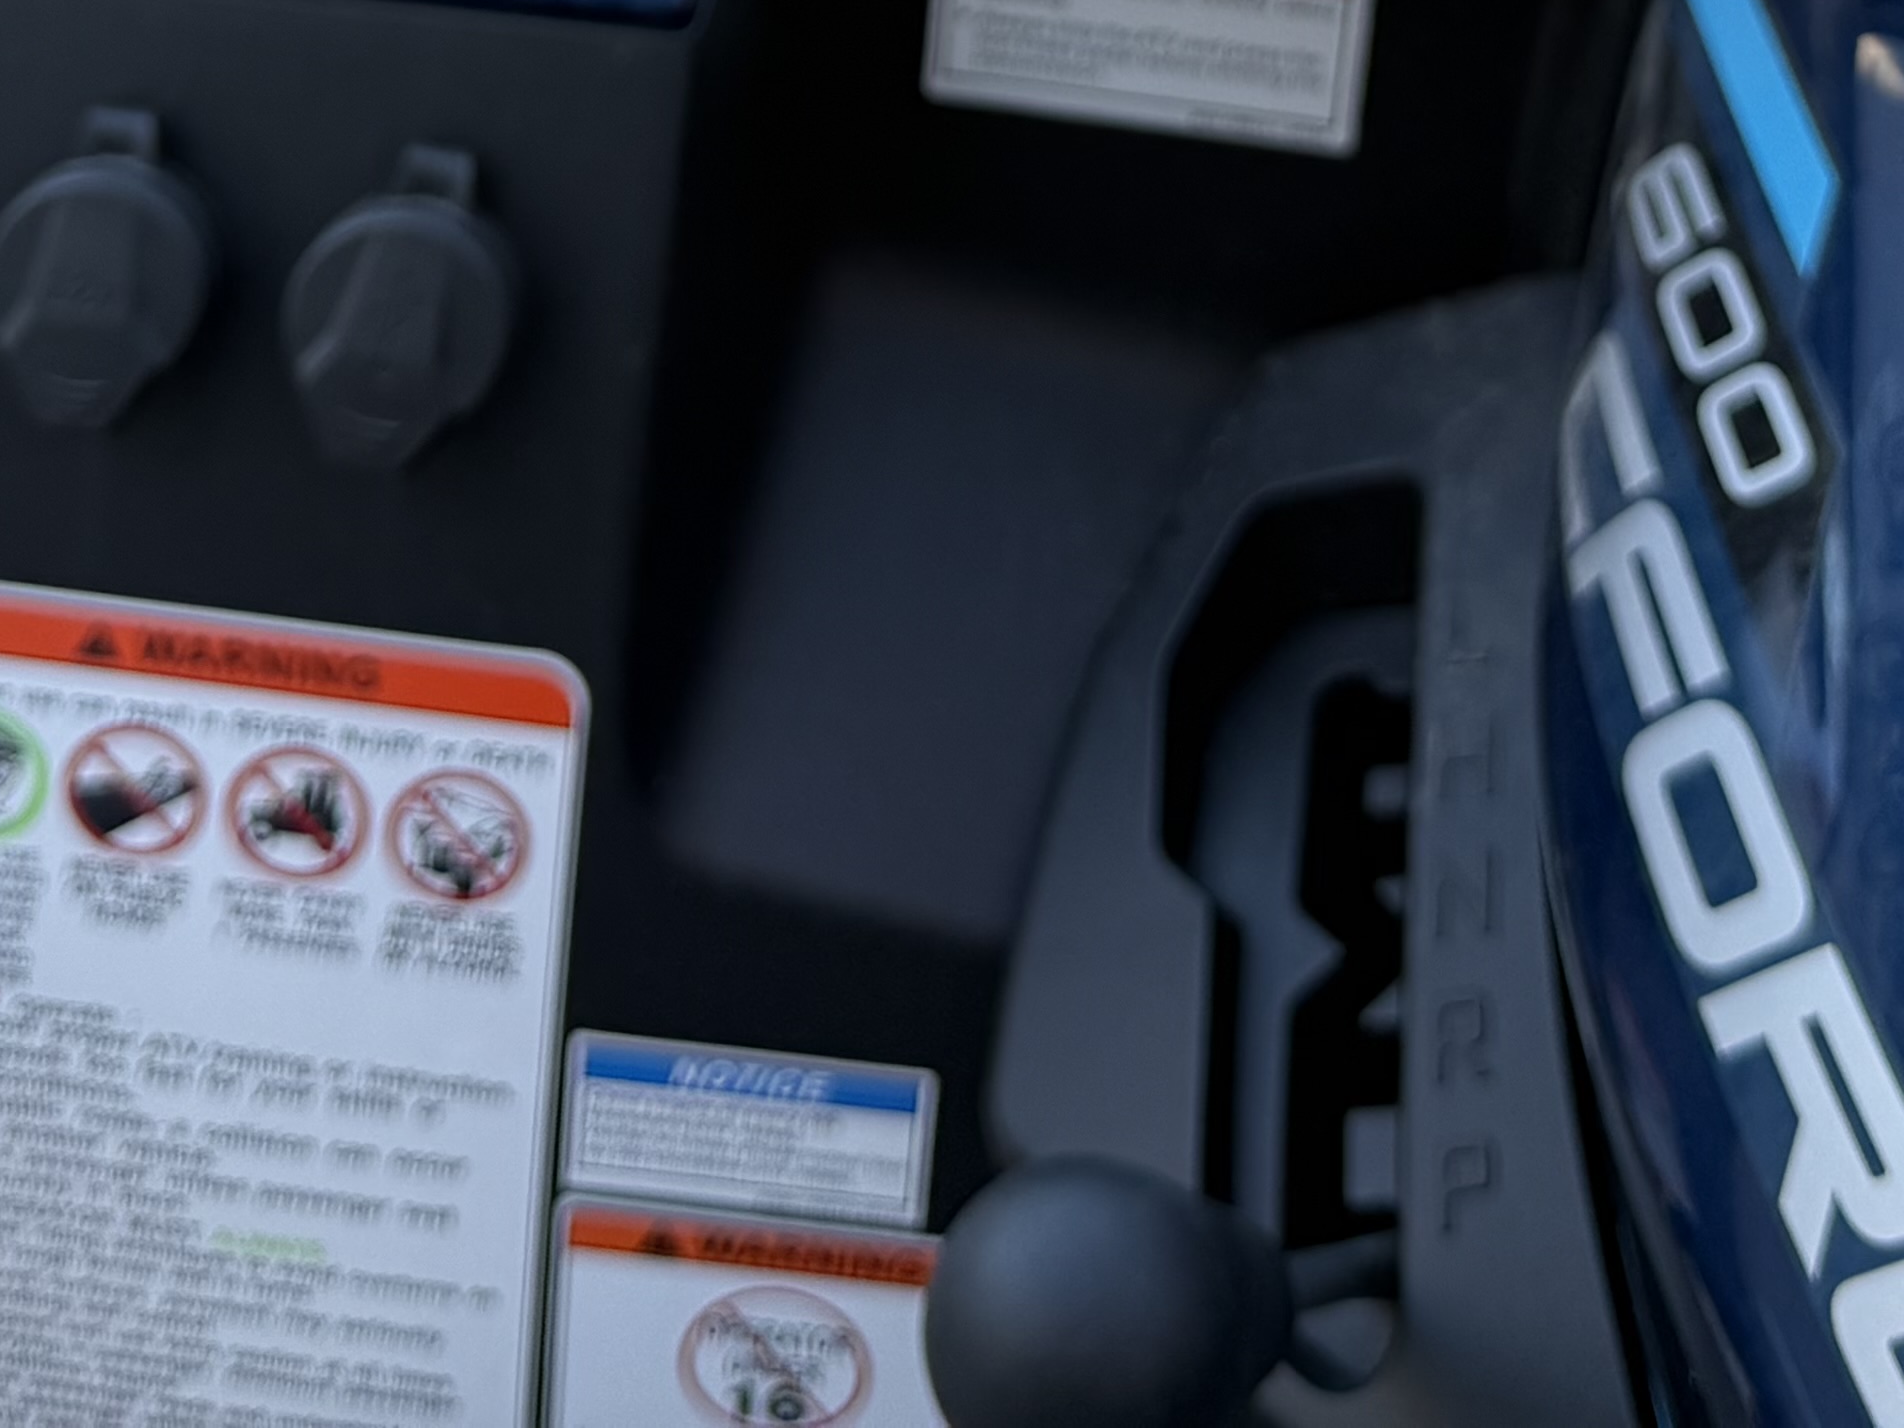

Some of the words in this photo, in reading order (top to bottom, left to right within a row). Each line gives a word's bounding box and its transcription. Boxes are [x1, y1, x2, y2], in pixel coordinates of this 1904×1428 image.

[1622, 142, 1818, 511] 600
[668, 1053, 834, 1102] NOTICE
[1435, 996, 1496, 1092] R
[1440, 1139, 1496, 1241] P
